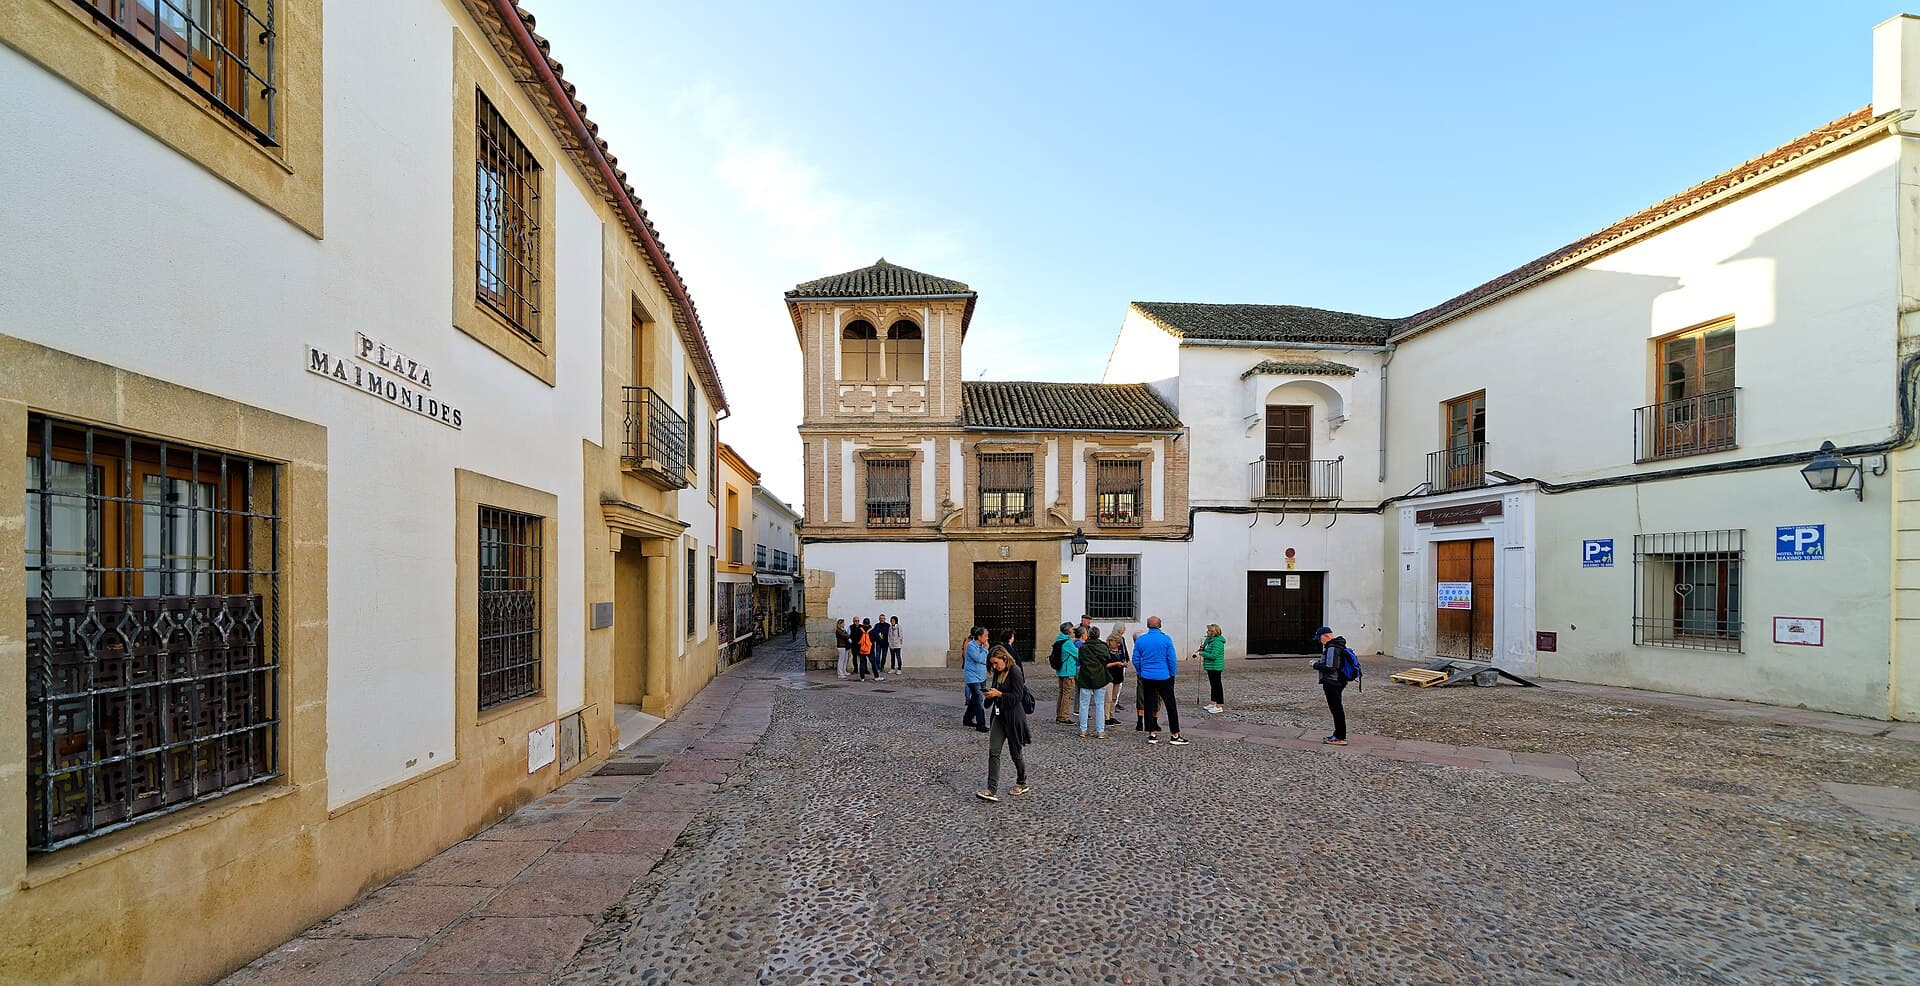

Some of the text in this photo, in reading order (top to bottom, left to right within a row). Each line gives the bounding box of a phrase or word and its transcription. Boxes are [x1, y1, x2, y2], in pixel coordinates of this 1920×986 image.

[360, 336, 432, 387] PLAZA
[310, 348, 463, 426] MAIMONIDES
[1585, 543, 1601, 560] P
[1795, 528, 1819, 551] P
